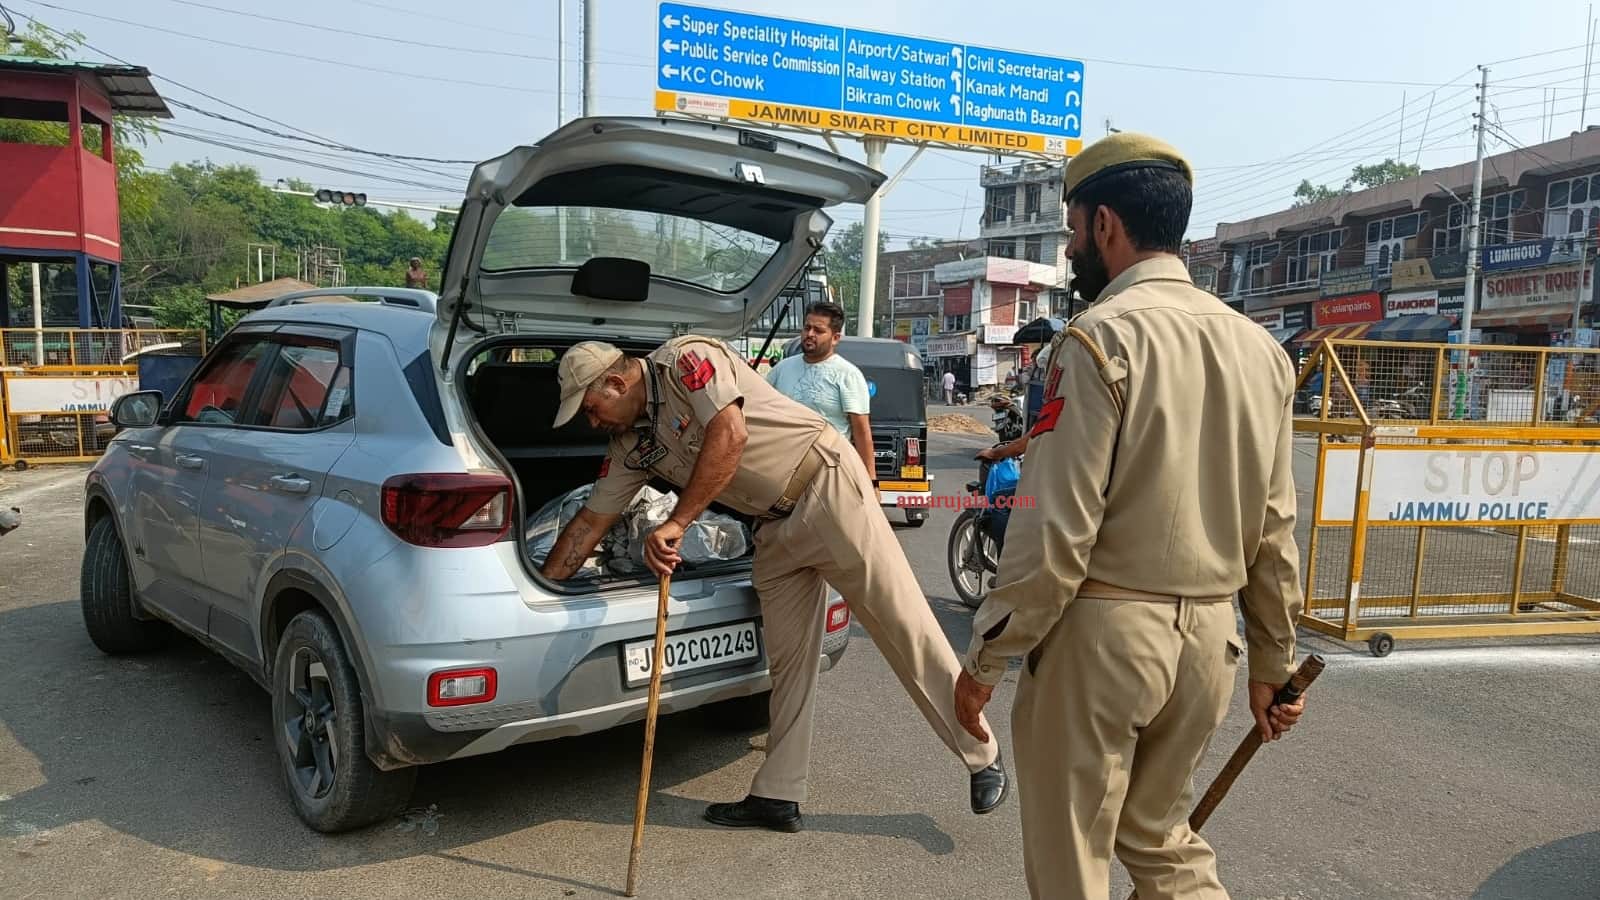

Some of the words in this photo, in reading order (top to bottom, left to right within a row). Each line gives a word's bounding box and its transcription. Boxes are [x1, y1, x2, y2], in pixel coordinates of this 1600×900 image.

[681, 14, 719, 36] Super
[723, 20, 788, 48] Speciality
[791, 29, 840, 52] Hospital
[681, 40, 719, 61] Public
[723, 46, 769, 66] Service
[773, 52, 840, 76] Commission
[847, 38, 950, 67] Airport/Satwari
[680, 65, 706, 83] KC
[710, 69, 765, 91] Chowk
[846, 63, 896, 86] Railway
[901, 69, 946, 90] Station
[967, 54, 995, 74] Civil
[997, 59, 1065, 83] Secretariat
[846, 86, 893, 107] Bikram
[896, 92, 941, 113] Chowk
[966, 78, 1006, 97] Kanak
[1010, 84, 1049, 104] Mandi
[748, 104, 820, 125] JAMMU
[829, 113, 899, 134] SMART
[907, 123, 950, 140] CITY
[958, 128, 1029, 149] LIMITED
[965, 101, 1027, 122] Raghunath
[1031, 109, 1064, 128] Bazar
[1489, 244, 1542, 264] LUMINOUS
[1544, 269, 1591, 292] HOUSE
[1331, 301, 1372, 315] asianpaints
[1396, 298, 1436, 311] ANCHOR
[61, 403, 107, 412] JAMMU
[1424, 450, 1540, 497] STOP
[1389, 502, 1470, 521] JAMMU
[1478, 501, 1549, 521] POLICE
[639, 629, 756, 672] J02CQ2249
